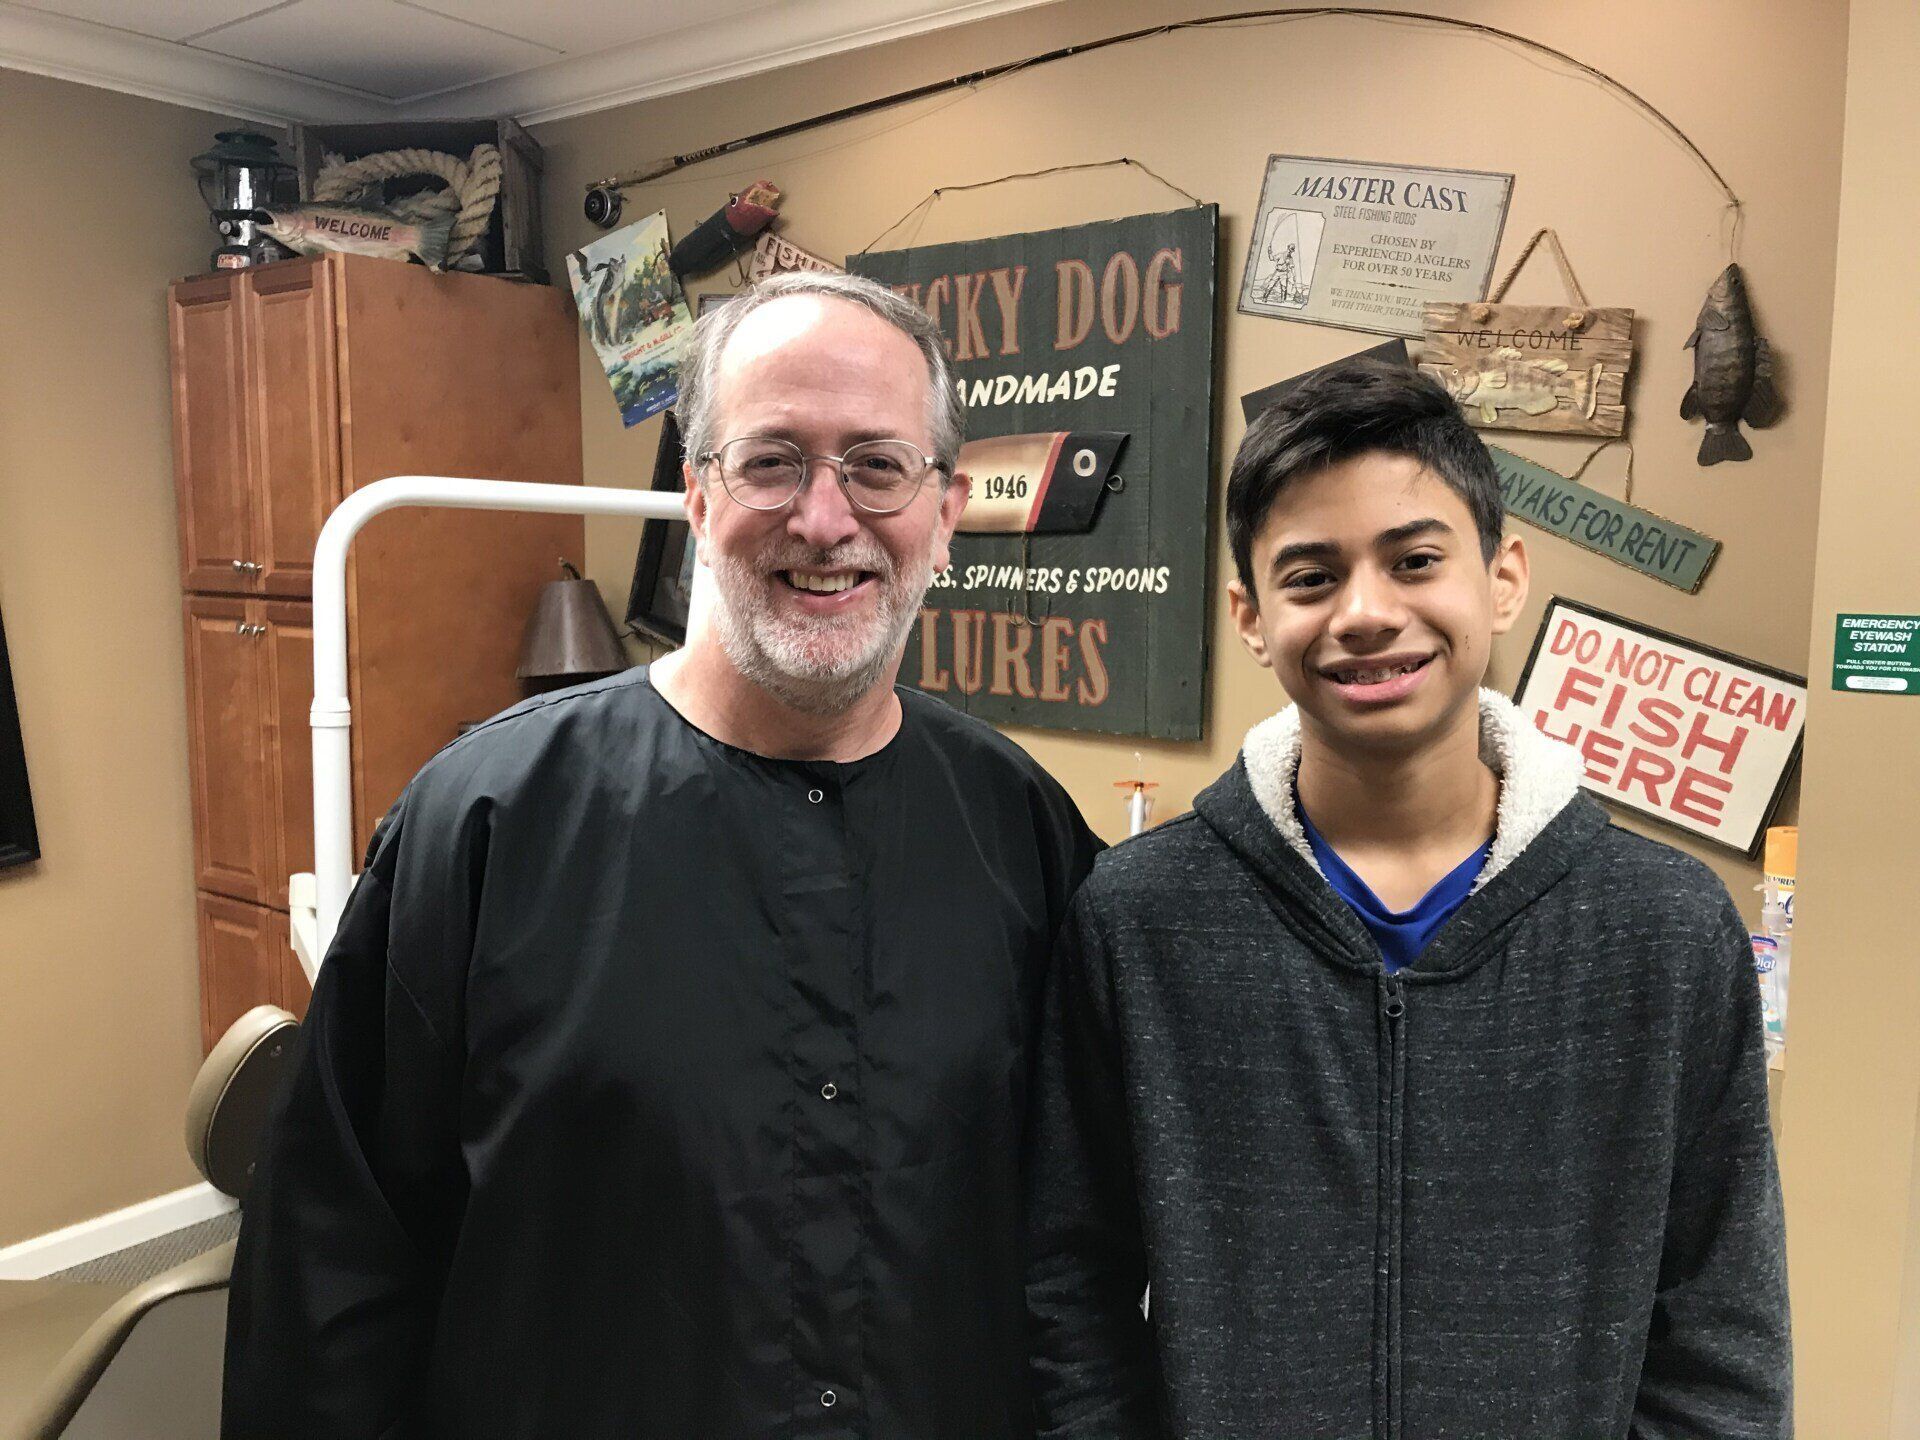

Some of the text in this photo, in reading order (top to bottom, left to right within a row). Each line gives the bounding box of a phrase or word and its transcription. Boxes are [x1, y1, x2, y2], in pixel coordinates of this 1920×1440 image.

[1292, 176, 1470, 213] MASTER CAST
[1333, 205, 1417, 226] STEEL FISHING RODS
[315, 216, 391, 240] WELCOME
[1370, 233, 1437, 251] CHOSEN BY
[1332, 243, 1471, 270] EXPERIENCED ANGLERS
[1342, 259, 1454, 283] FOR OVER 50 YEARS
[892, 247, 1184, 362] CKY DOG
[1330, 287, 1344, 296] WE
[1345, 289, 1374, 301] THINK
[1374, 293, 1394, 304] YOU
[1395, 295, 1420, 308] WILL
[1331, 298, 1355, 310] WITH
[1355, 302, 1384, 314] THEIR
[1457, 328, 1586, 351] WELCOME
[957, 364, 1121, 407] ANDMADE
[985, 474, 1028, 499] 1946
[1495, 463, 1697, 574] AYAKS FOR RENT
[963, 564, 1061, 592] SPINNERS
[1065, 570, 1079, 594] &
[1083, 566, 1170, 594] SPOONS
[1842, 618, 1920, 629] EMERGENCY
[1850, 630, 1912, 641] EYEWASH
[919, 608, 1110, 706] LURES
[1853, 642, 1906, 653] STATION
[1550, 619, 1796, 732] DO NOT CLEAN
[1553, 667, 1749, 775] FISH
